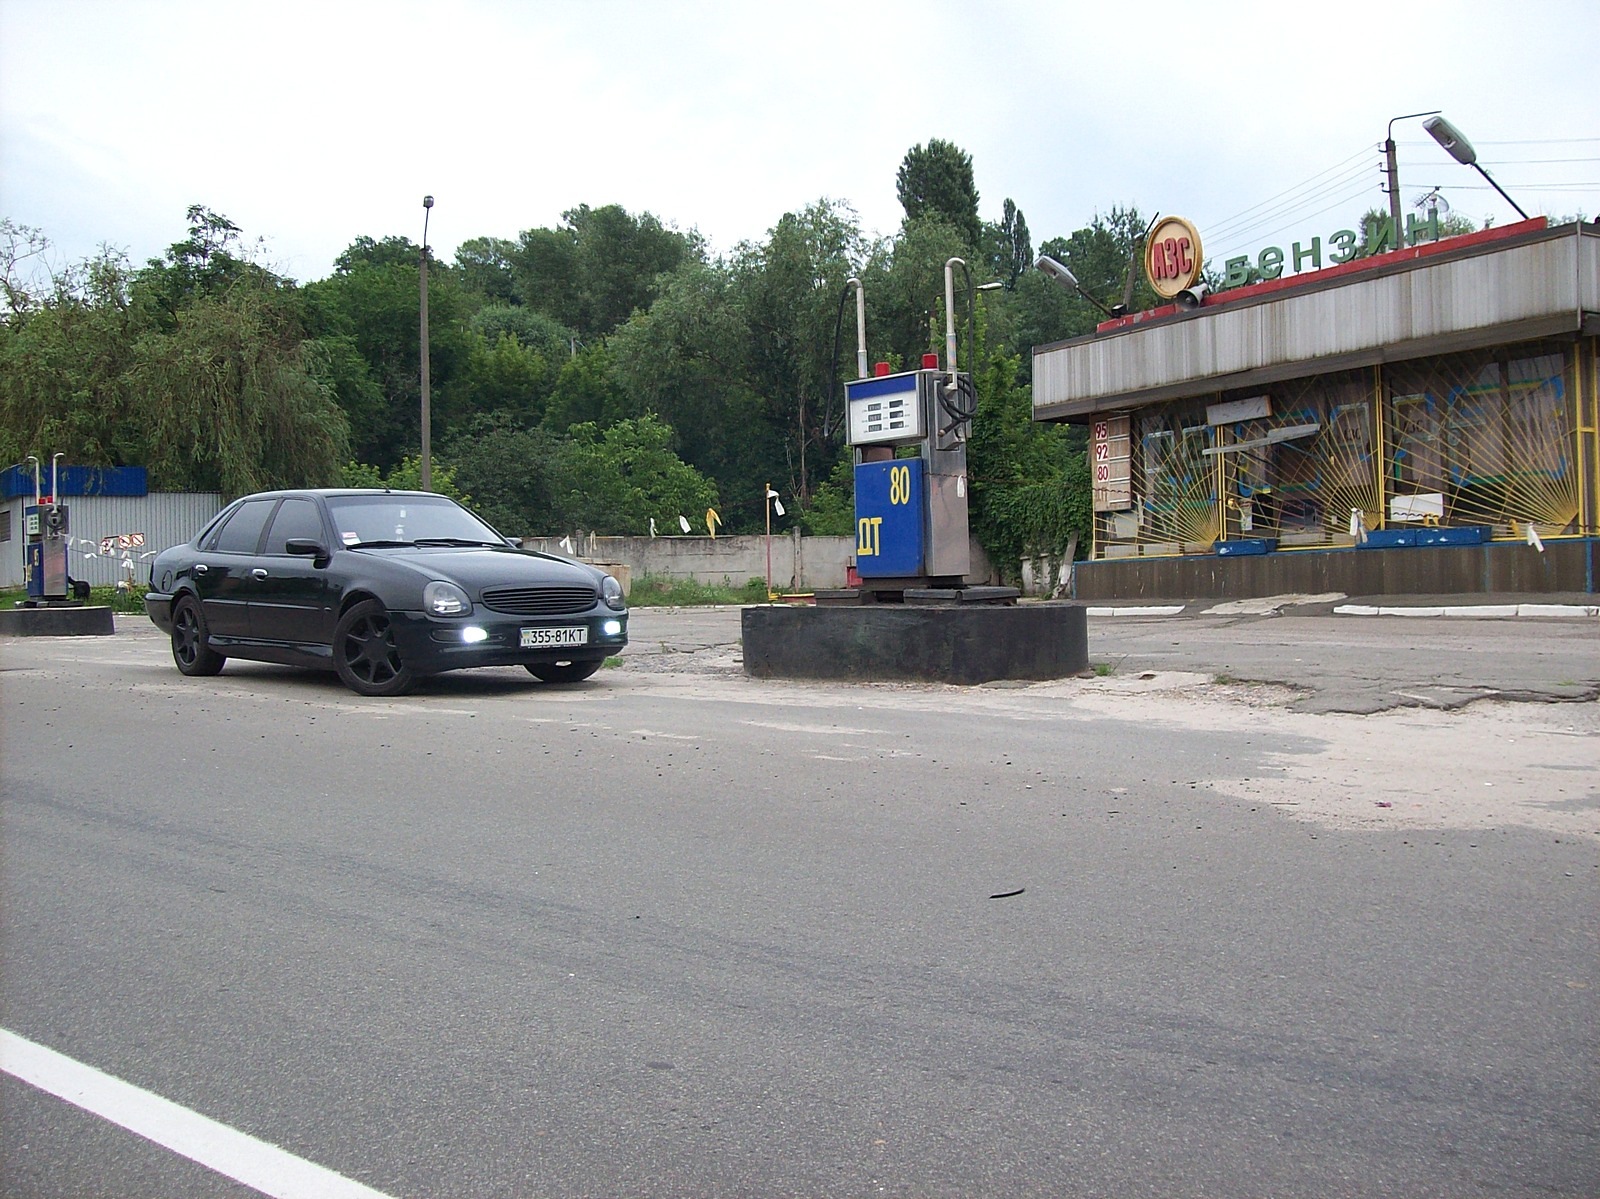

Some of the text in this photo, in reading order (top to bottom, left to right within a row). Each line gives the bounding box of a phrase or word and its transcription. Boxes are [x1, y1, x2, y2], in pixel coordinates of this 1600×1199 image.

[1153, 237, 1193, 279] АЗС
[1095, 423, 1107, 439] 95
[1096, 444, 1108, 460] 92
[1097, 465, 1109, 481] 80
[890, 466, 910, 505] 80
[857, 517, 882, 556] ДТ
[531, 629, 585, 644] 355-81KT
